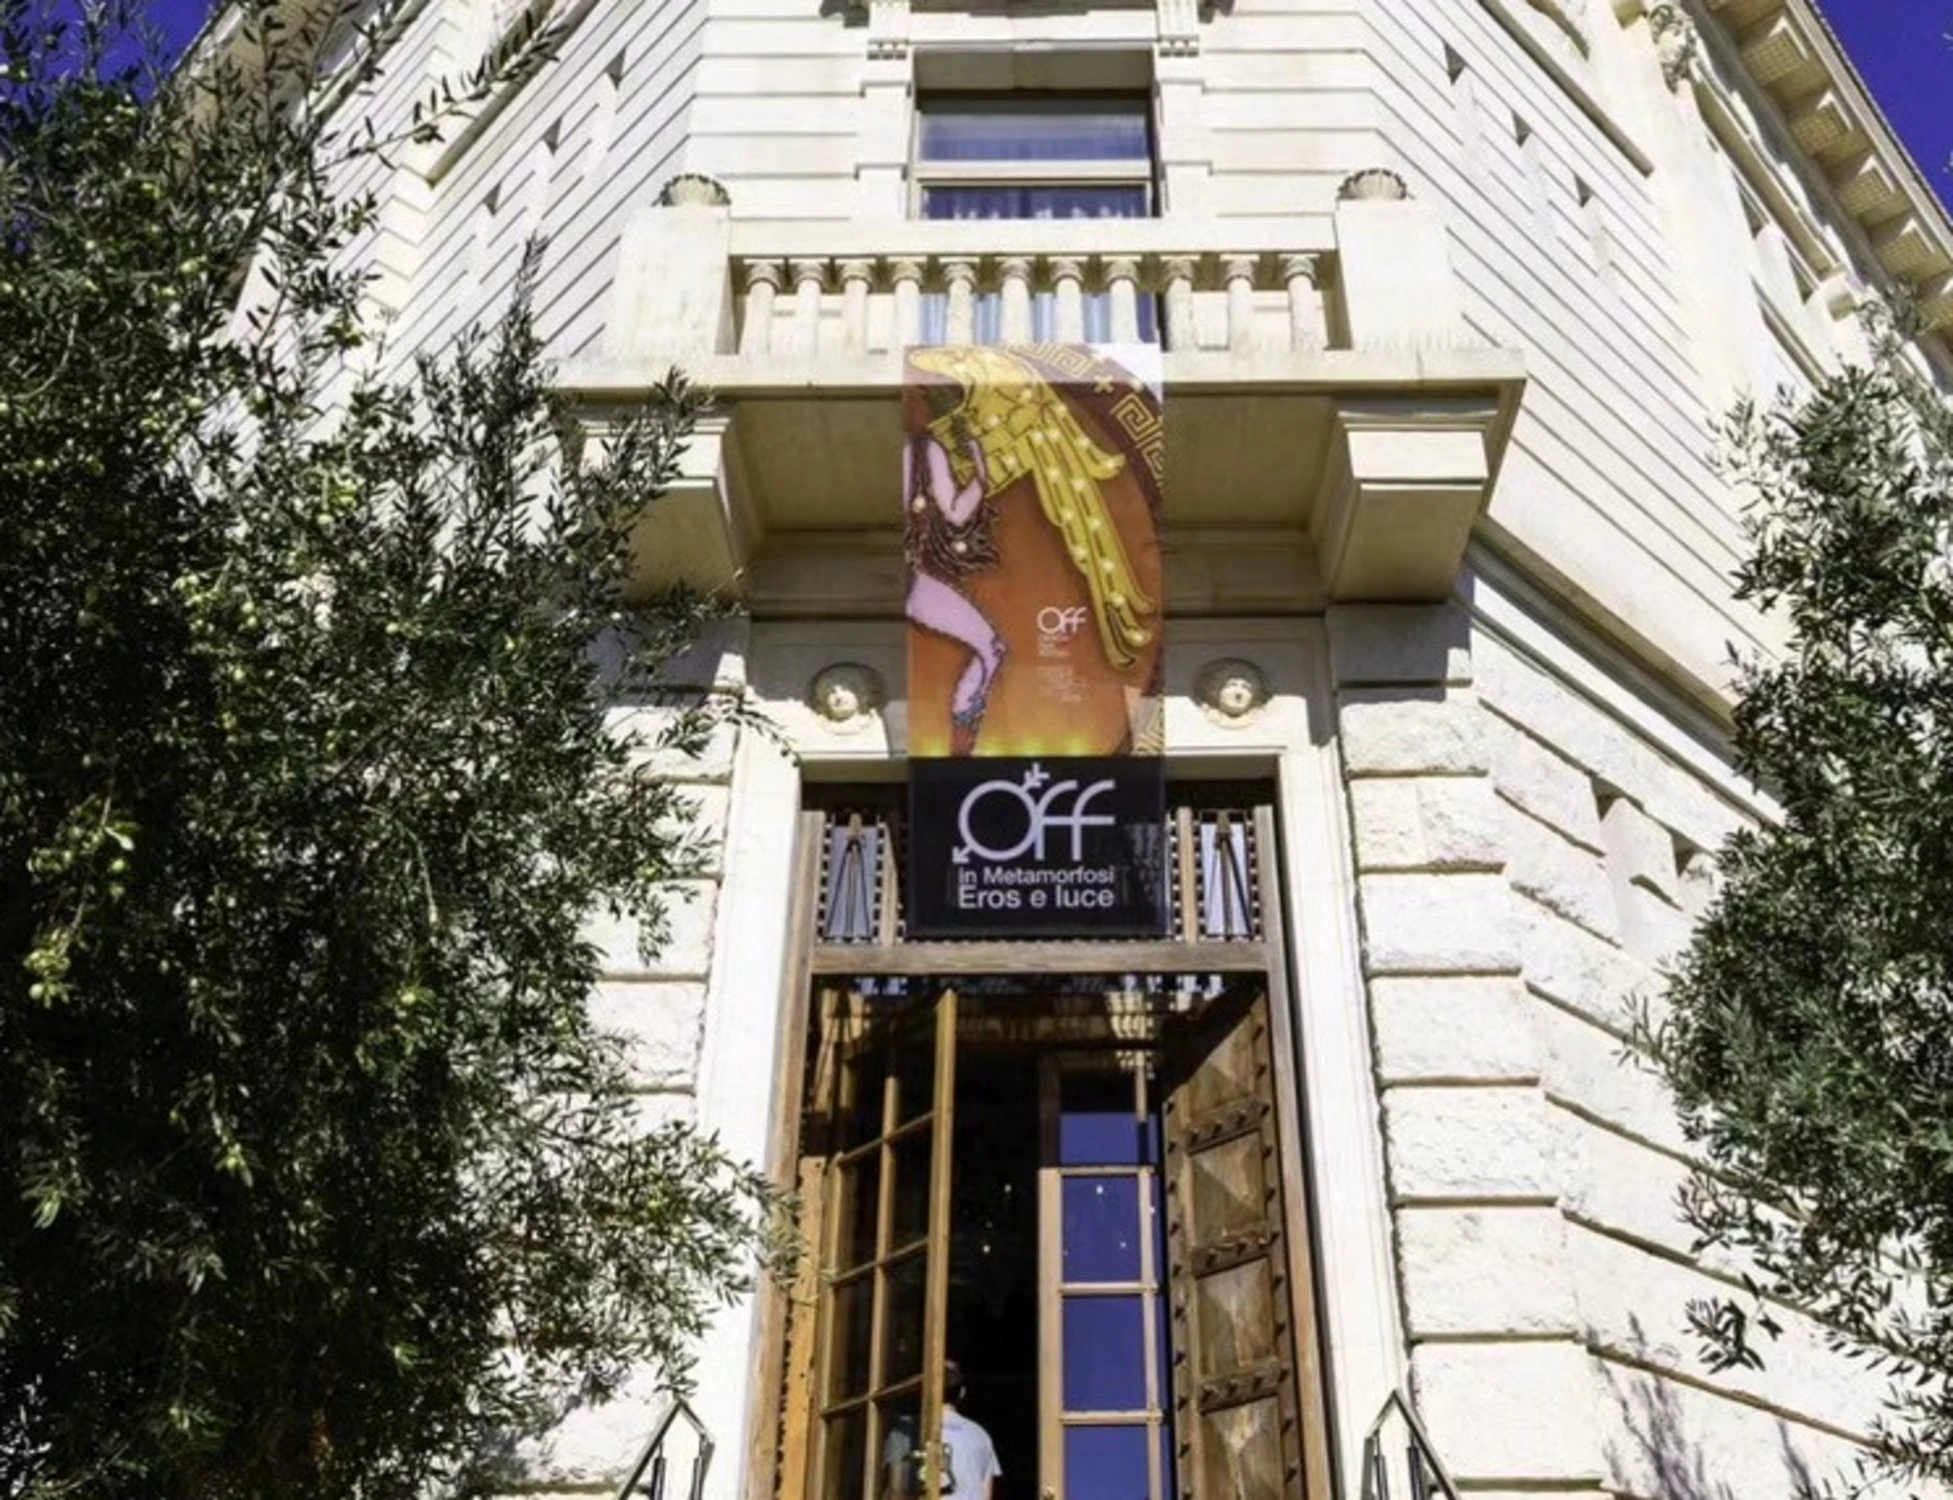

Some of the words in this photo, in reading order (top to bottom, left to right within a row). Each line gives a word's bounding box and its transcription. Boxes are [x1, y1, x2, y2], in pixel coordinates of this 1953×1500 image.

[1036, 606, 1087, 634] Off
[953, 766, 1116, 863] Off
[983, 865, 1115, 884] Metamorfosi
[958, 884, 1022, 909] Eros
[1029, 888, 1047, 908] e
[1055, 884, 1115, 908] luce
